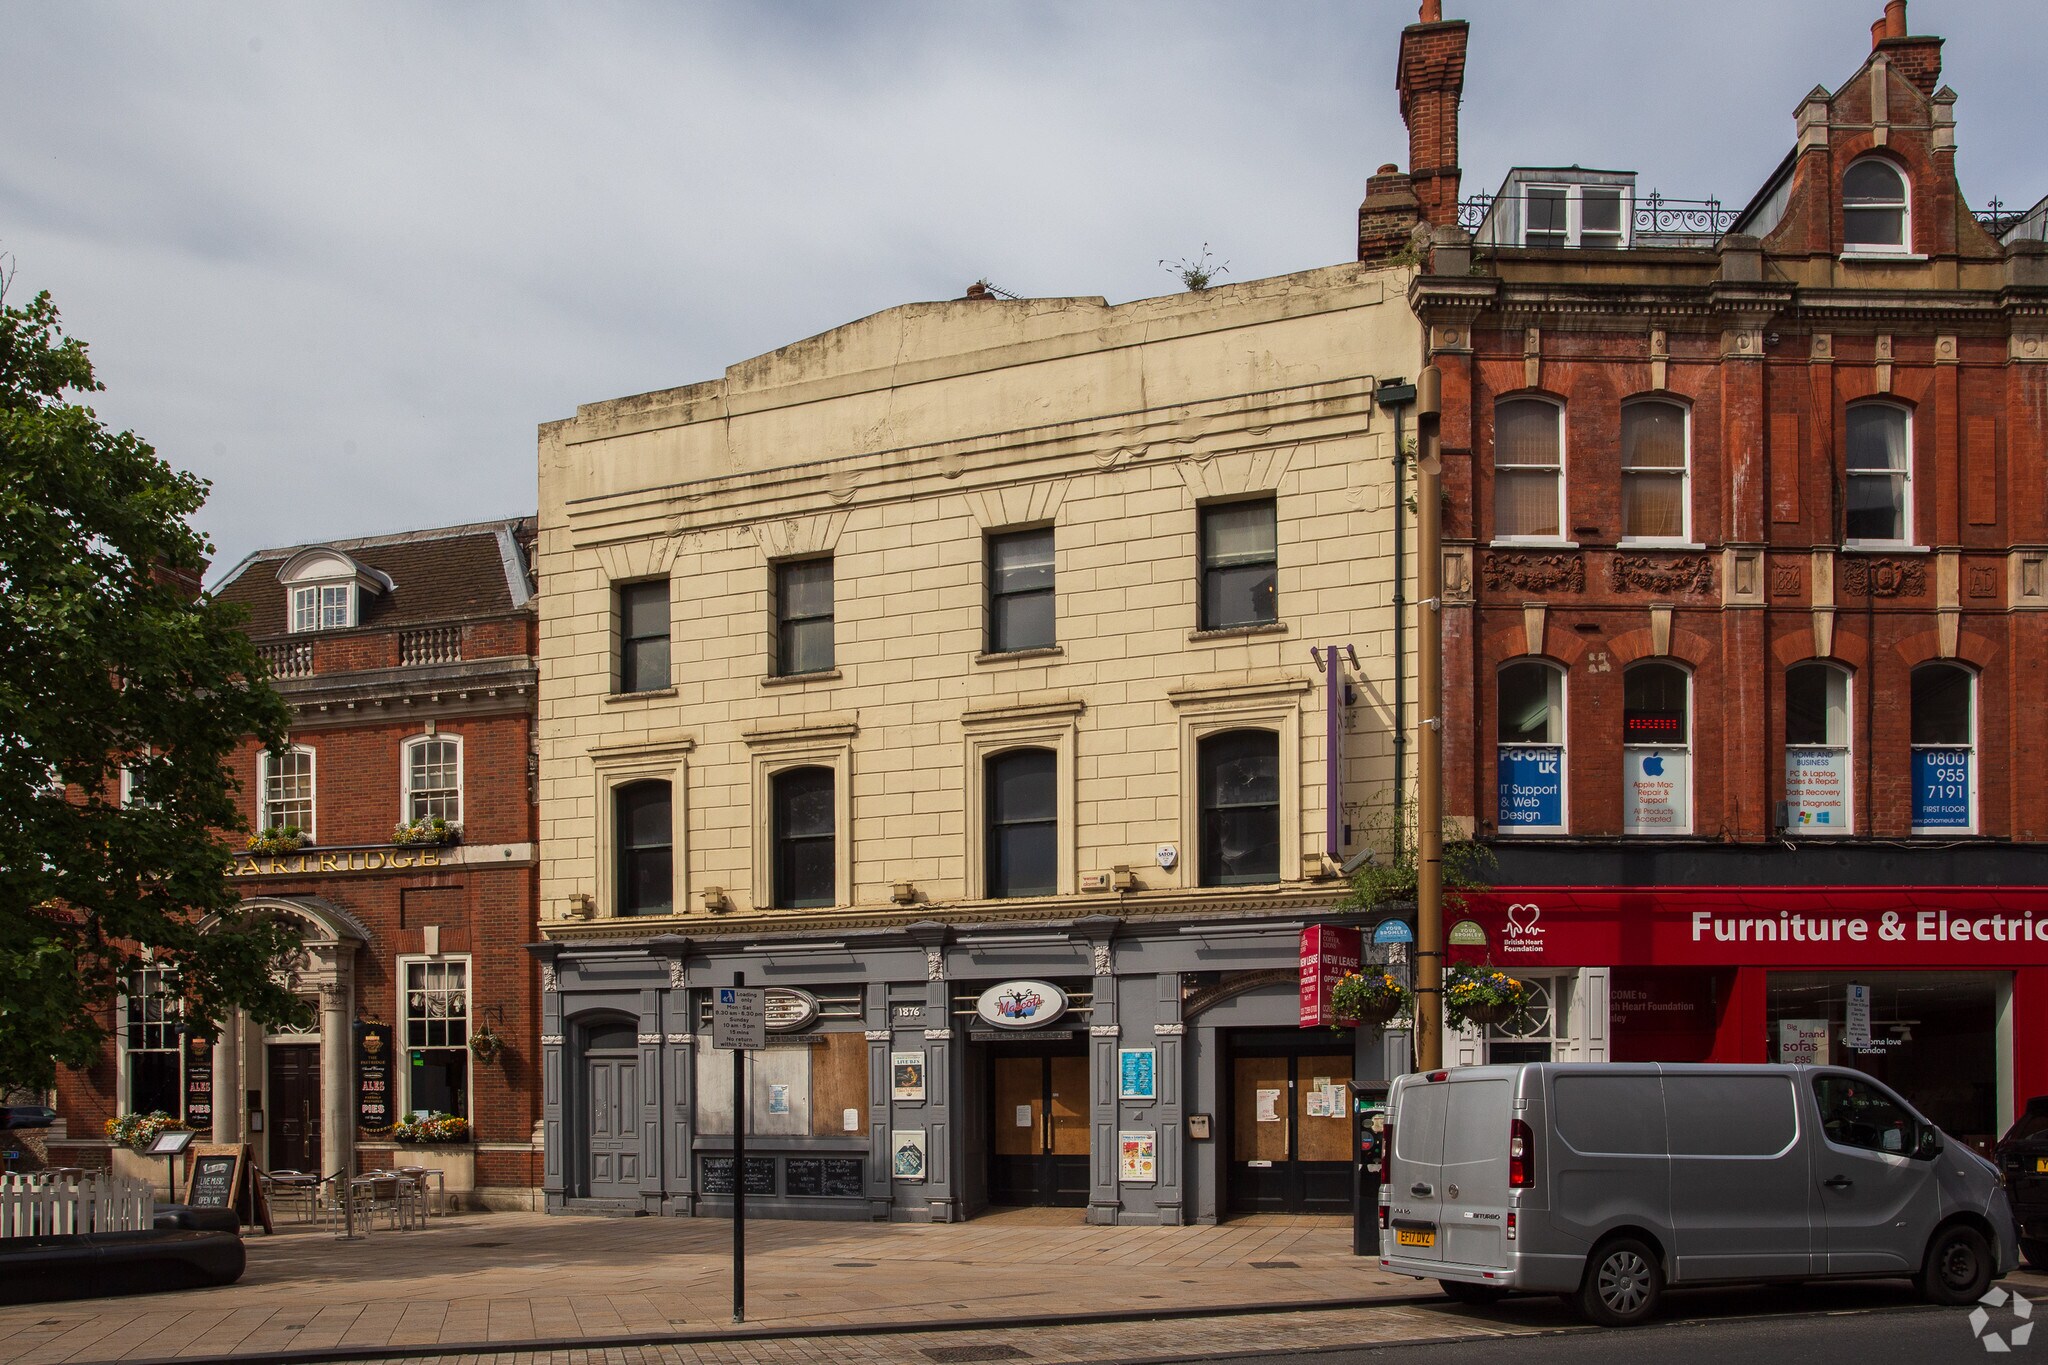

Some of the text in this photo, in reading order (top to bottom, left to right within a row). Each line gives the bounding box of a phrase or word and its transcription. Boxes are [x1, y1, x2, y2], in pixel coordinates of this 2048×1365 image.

[1927, 753, 1964, 765] 0800
[1539, 762, 1557, 773] UK
[1937, 769, 1964, 782] 955
[1501, 784, 1557, 796] IT Support
[1928, 786, 1962, 798] 7191
[1501, 797, 1539, 807] & Web
[1803, 800, 1841, 808] Diagnostic
[1501, 810, 1540, 822] Design
[1692, 911, 1868, 941] Furniture
[1878, 911, 1906, 941] &
[1309, 954, 1318, 965] LEASE
[1322, 954, 1358, 968] NEW LEASE
[1611, 990, 1636, 999] COME
[997, 994, 1040, 1016] Mascots
[1622, 1002, 1645, 1010] Heart
[1648, 1002, 1693, 1010] Foundation
[899, 1007, 920, 1017] 1876
[1800, 1030, 1825, 1038] brand
[1783, 1041, 1818, 1052] sofas
[1795, 1056, 1811, 1064] £95
[190, 1082, 210, 1092] ALES
[362, 1081, 385, 1091] ALES
[189, 1105, 210, 1113] PIES
[362, 1104, 385, 1113] PIES
[1401, 1231, 1415, 1242] EF17
